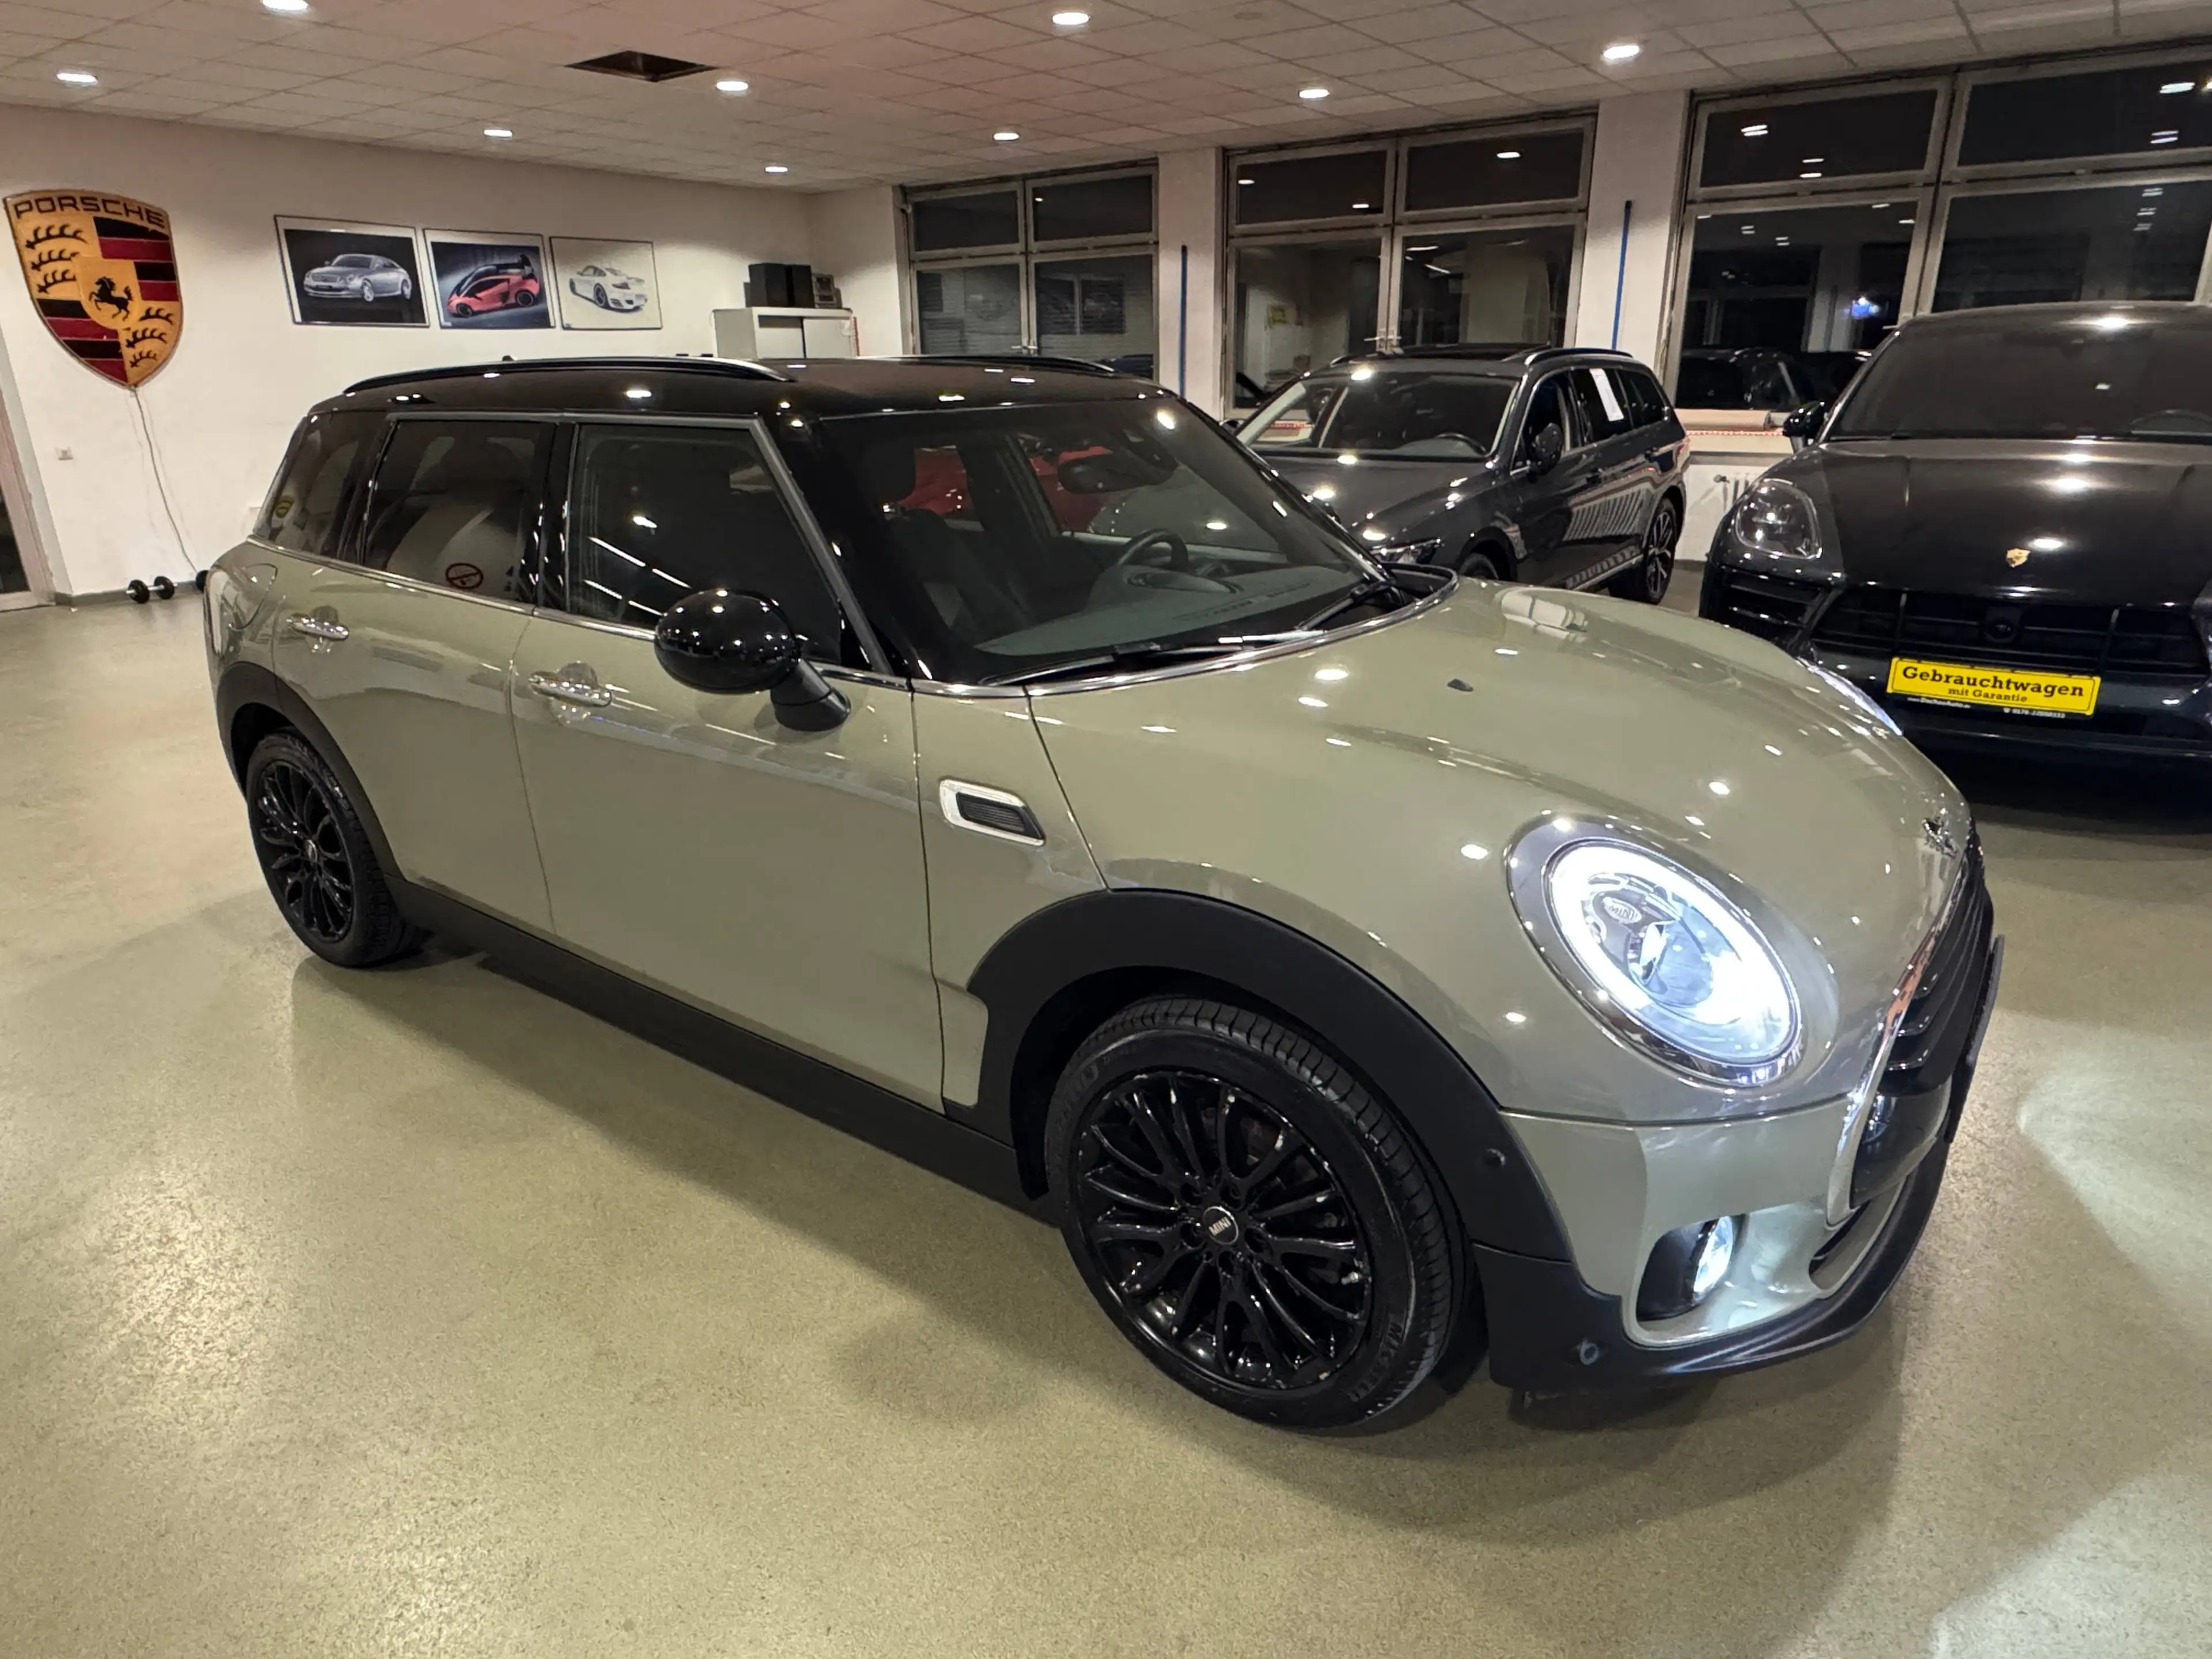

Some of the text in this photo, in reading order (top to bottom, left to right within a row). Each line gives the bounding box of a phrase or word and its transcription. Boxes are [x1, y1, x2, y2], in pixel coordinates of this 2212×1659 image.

[13, 196, 165, 229] PORSCHE
[1902, 666, 2084, 697] Gebrauchtwagen
[1948, 687, 2028, 702] mit Garantie
[1209, 1217, 1231, 1236] MINI
